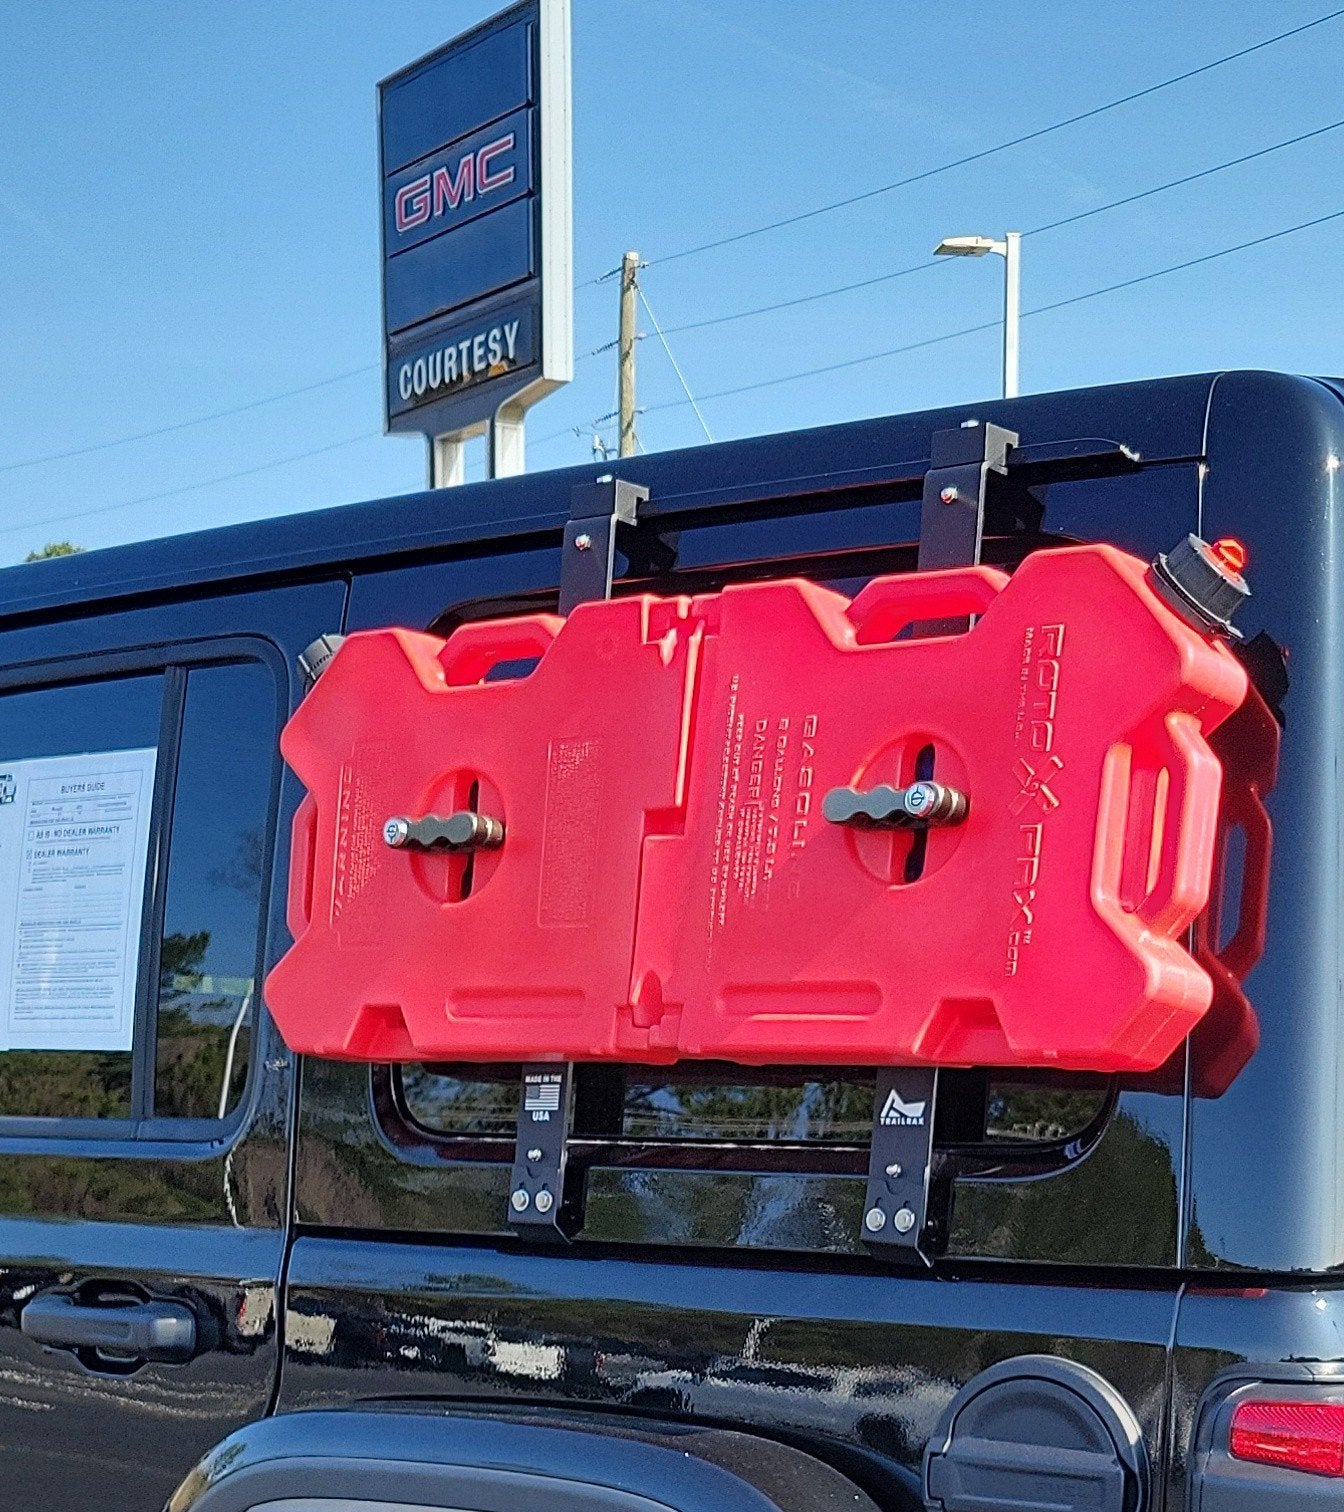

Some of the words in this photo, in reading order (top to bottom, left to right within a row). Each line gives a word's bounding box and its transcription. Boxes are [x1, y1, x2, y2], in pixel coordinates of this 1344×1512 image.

[394, 132, 515, 233] GMC
[398, 319, 520, 401] COURTESY
[1031, 623, 1064, 752] ROTO
[749, 718, 768, 799] DANGER
[788, 714, 818, 898] GASOLIE
[1010, 822, 1043, 925] PAX
[525, 1075, 542, 1083] MADE
[532, 1110, 550, 1122] USA
